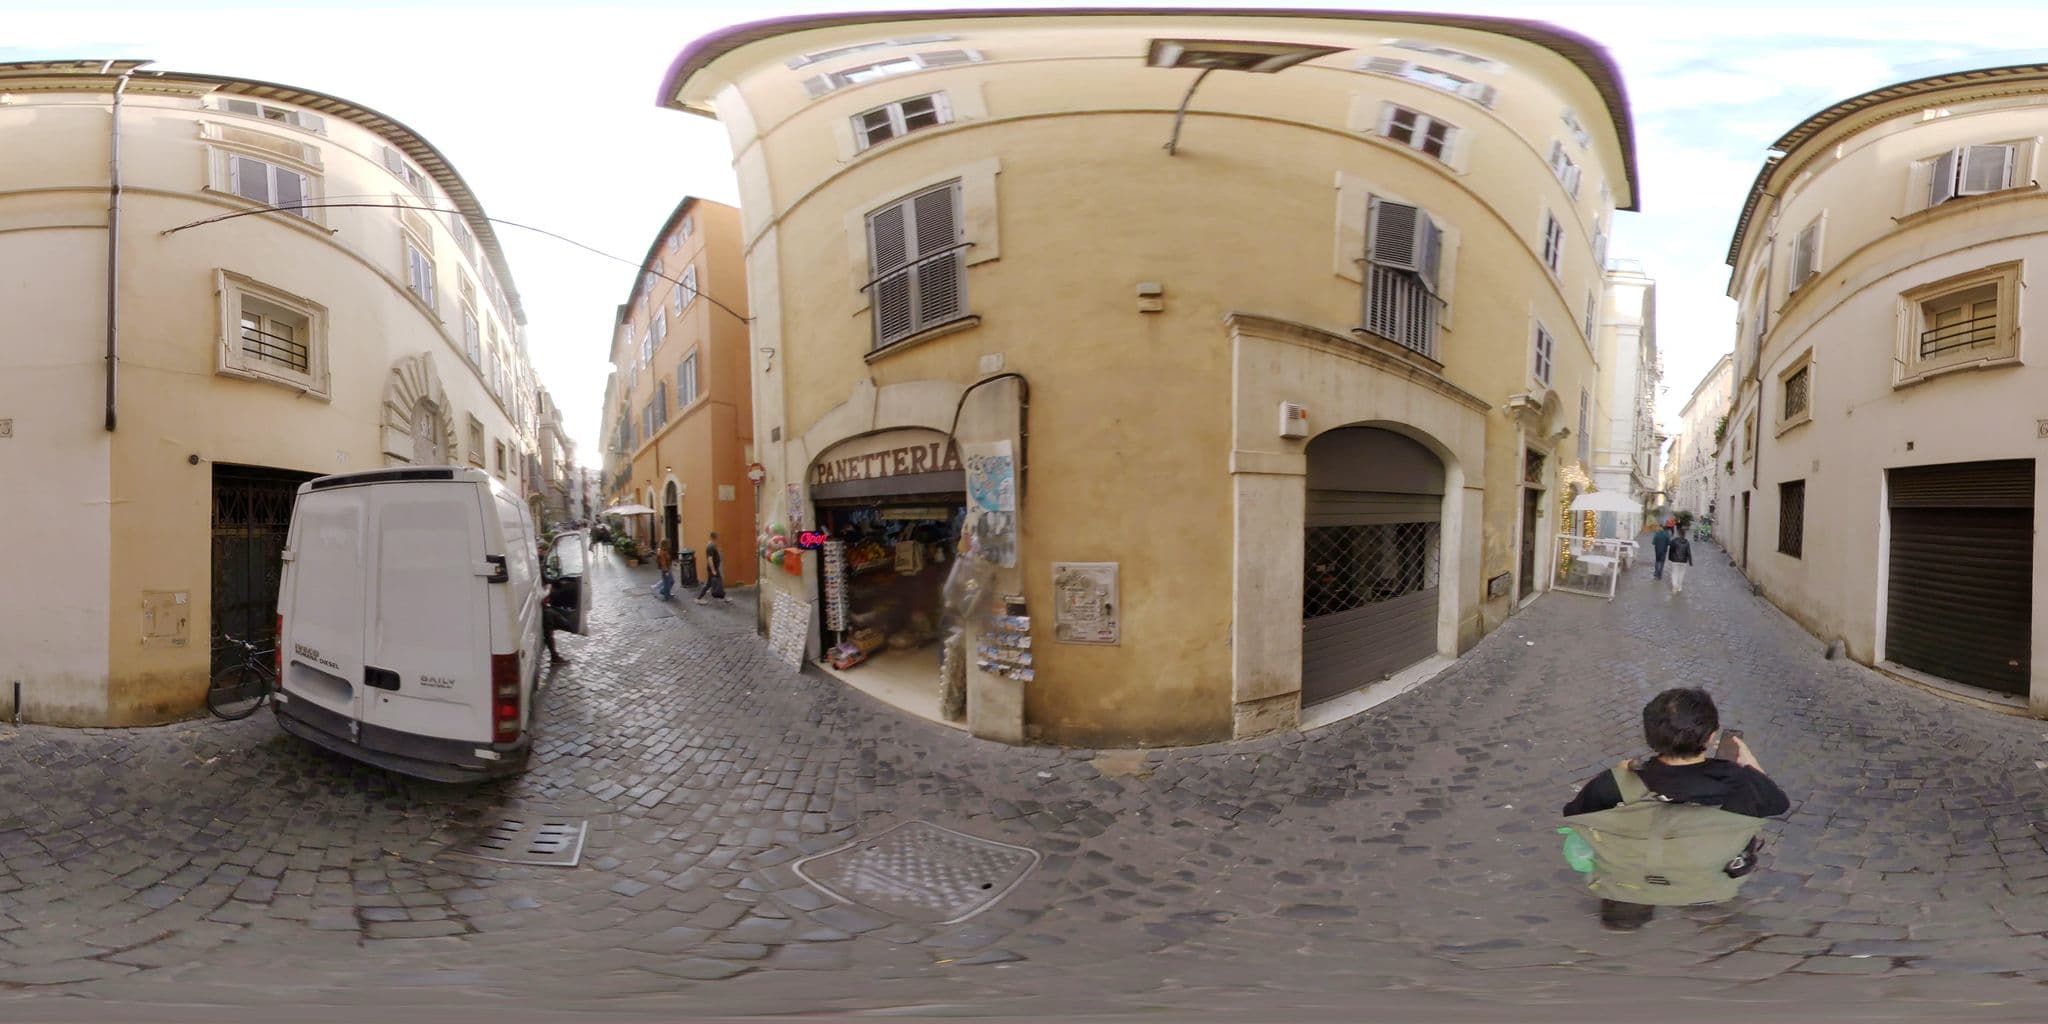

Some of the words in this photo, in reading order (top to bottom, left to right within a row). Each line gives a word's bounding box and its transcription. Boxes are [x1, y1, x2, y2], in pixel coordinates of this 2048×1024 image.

[816, 438, 965, 485] PANETTERIA
[800, 532, 828, 548] Open
[319, 658, 340, 670] DIESEL
[420, 675, 456, 686] DAILY
